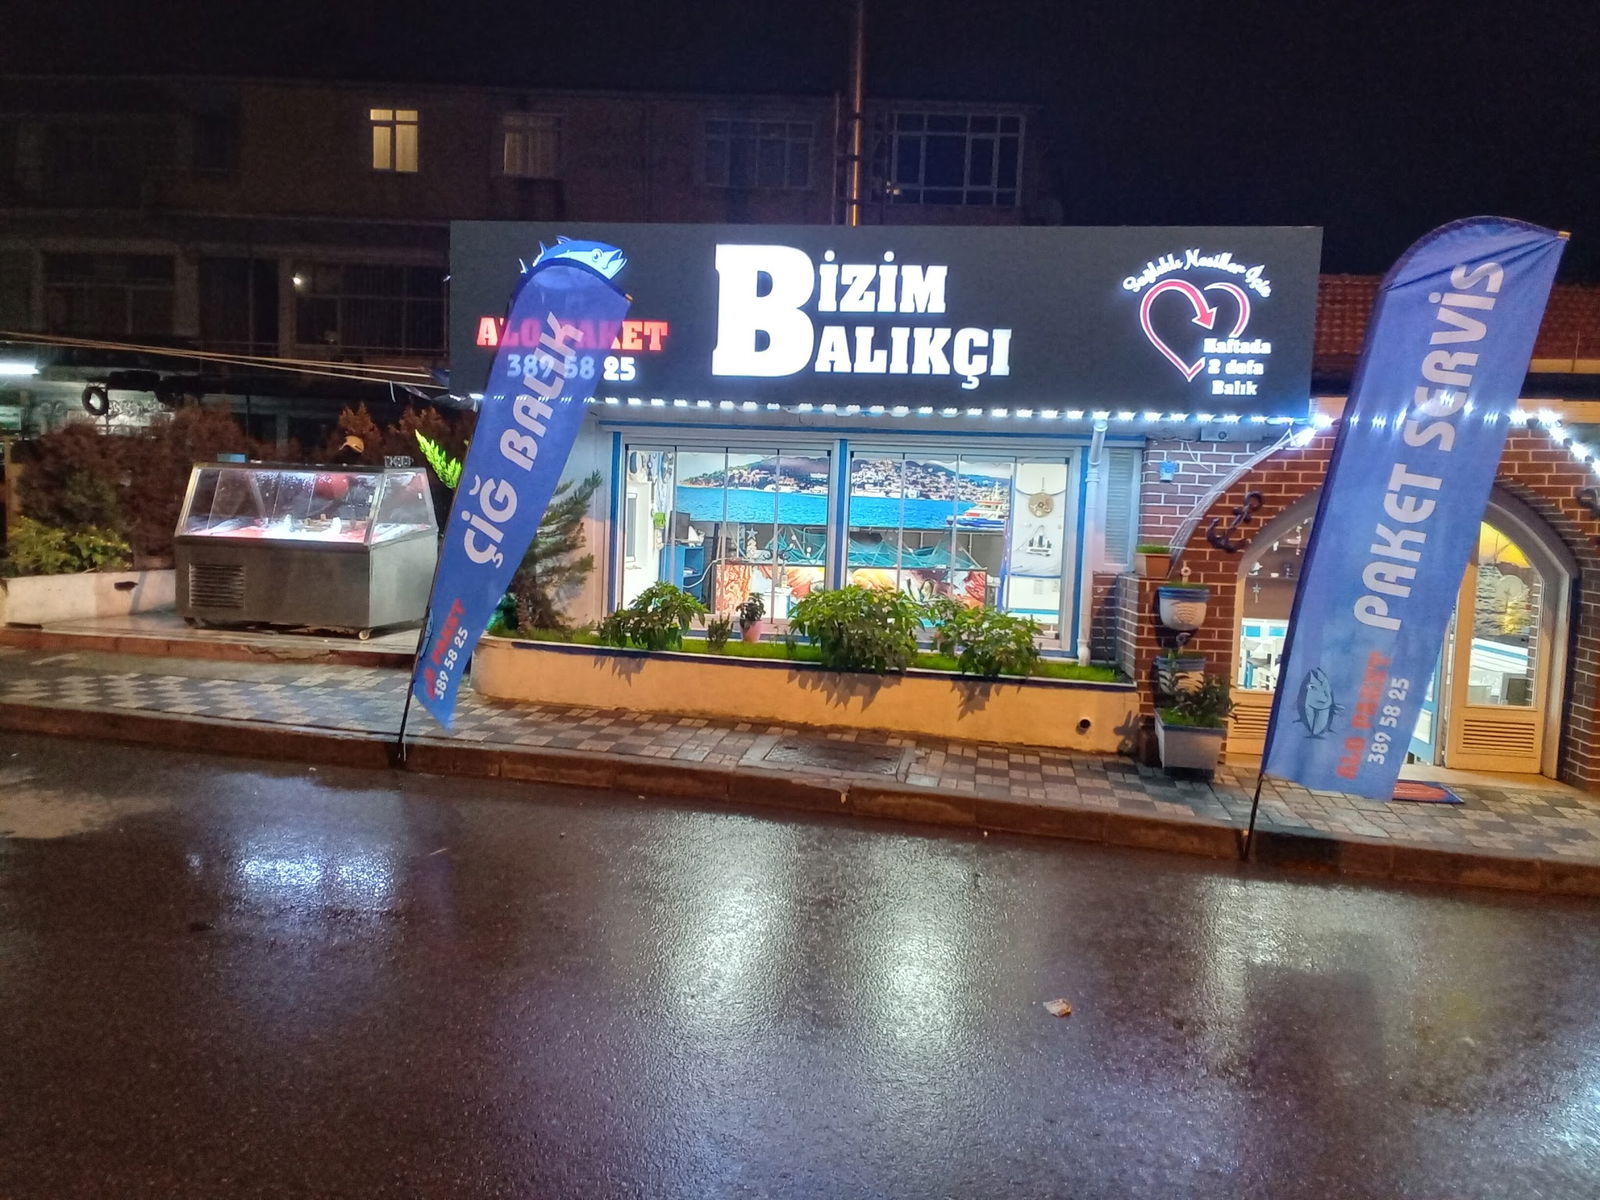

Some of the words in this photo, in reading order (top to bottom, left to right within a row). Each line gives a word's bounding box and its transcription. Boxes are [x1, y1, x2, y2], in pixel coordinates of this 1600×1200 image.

[564, 356, 595, 380] 58
[603, 356, 636, 381] 25
[1208, 359, 1221, 374] 2
[500, 311, 584, 472] BALIK
[1353, 462, 1443, 631] PAKET
[1403, 260, 1505, 453] SERVİS
[443, 648, 458, 671] 58
[454, 626, 468, 649] 25
[1388, 677, 1410, 701] 25
[1379, 704, 1401, 728] 58
[1367, 731, 1392, 765] 389
